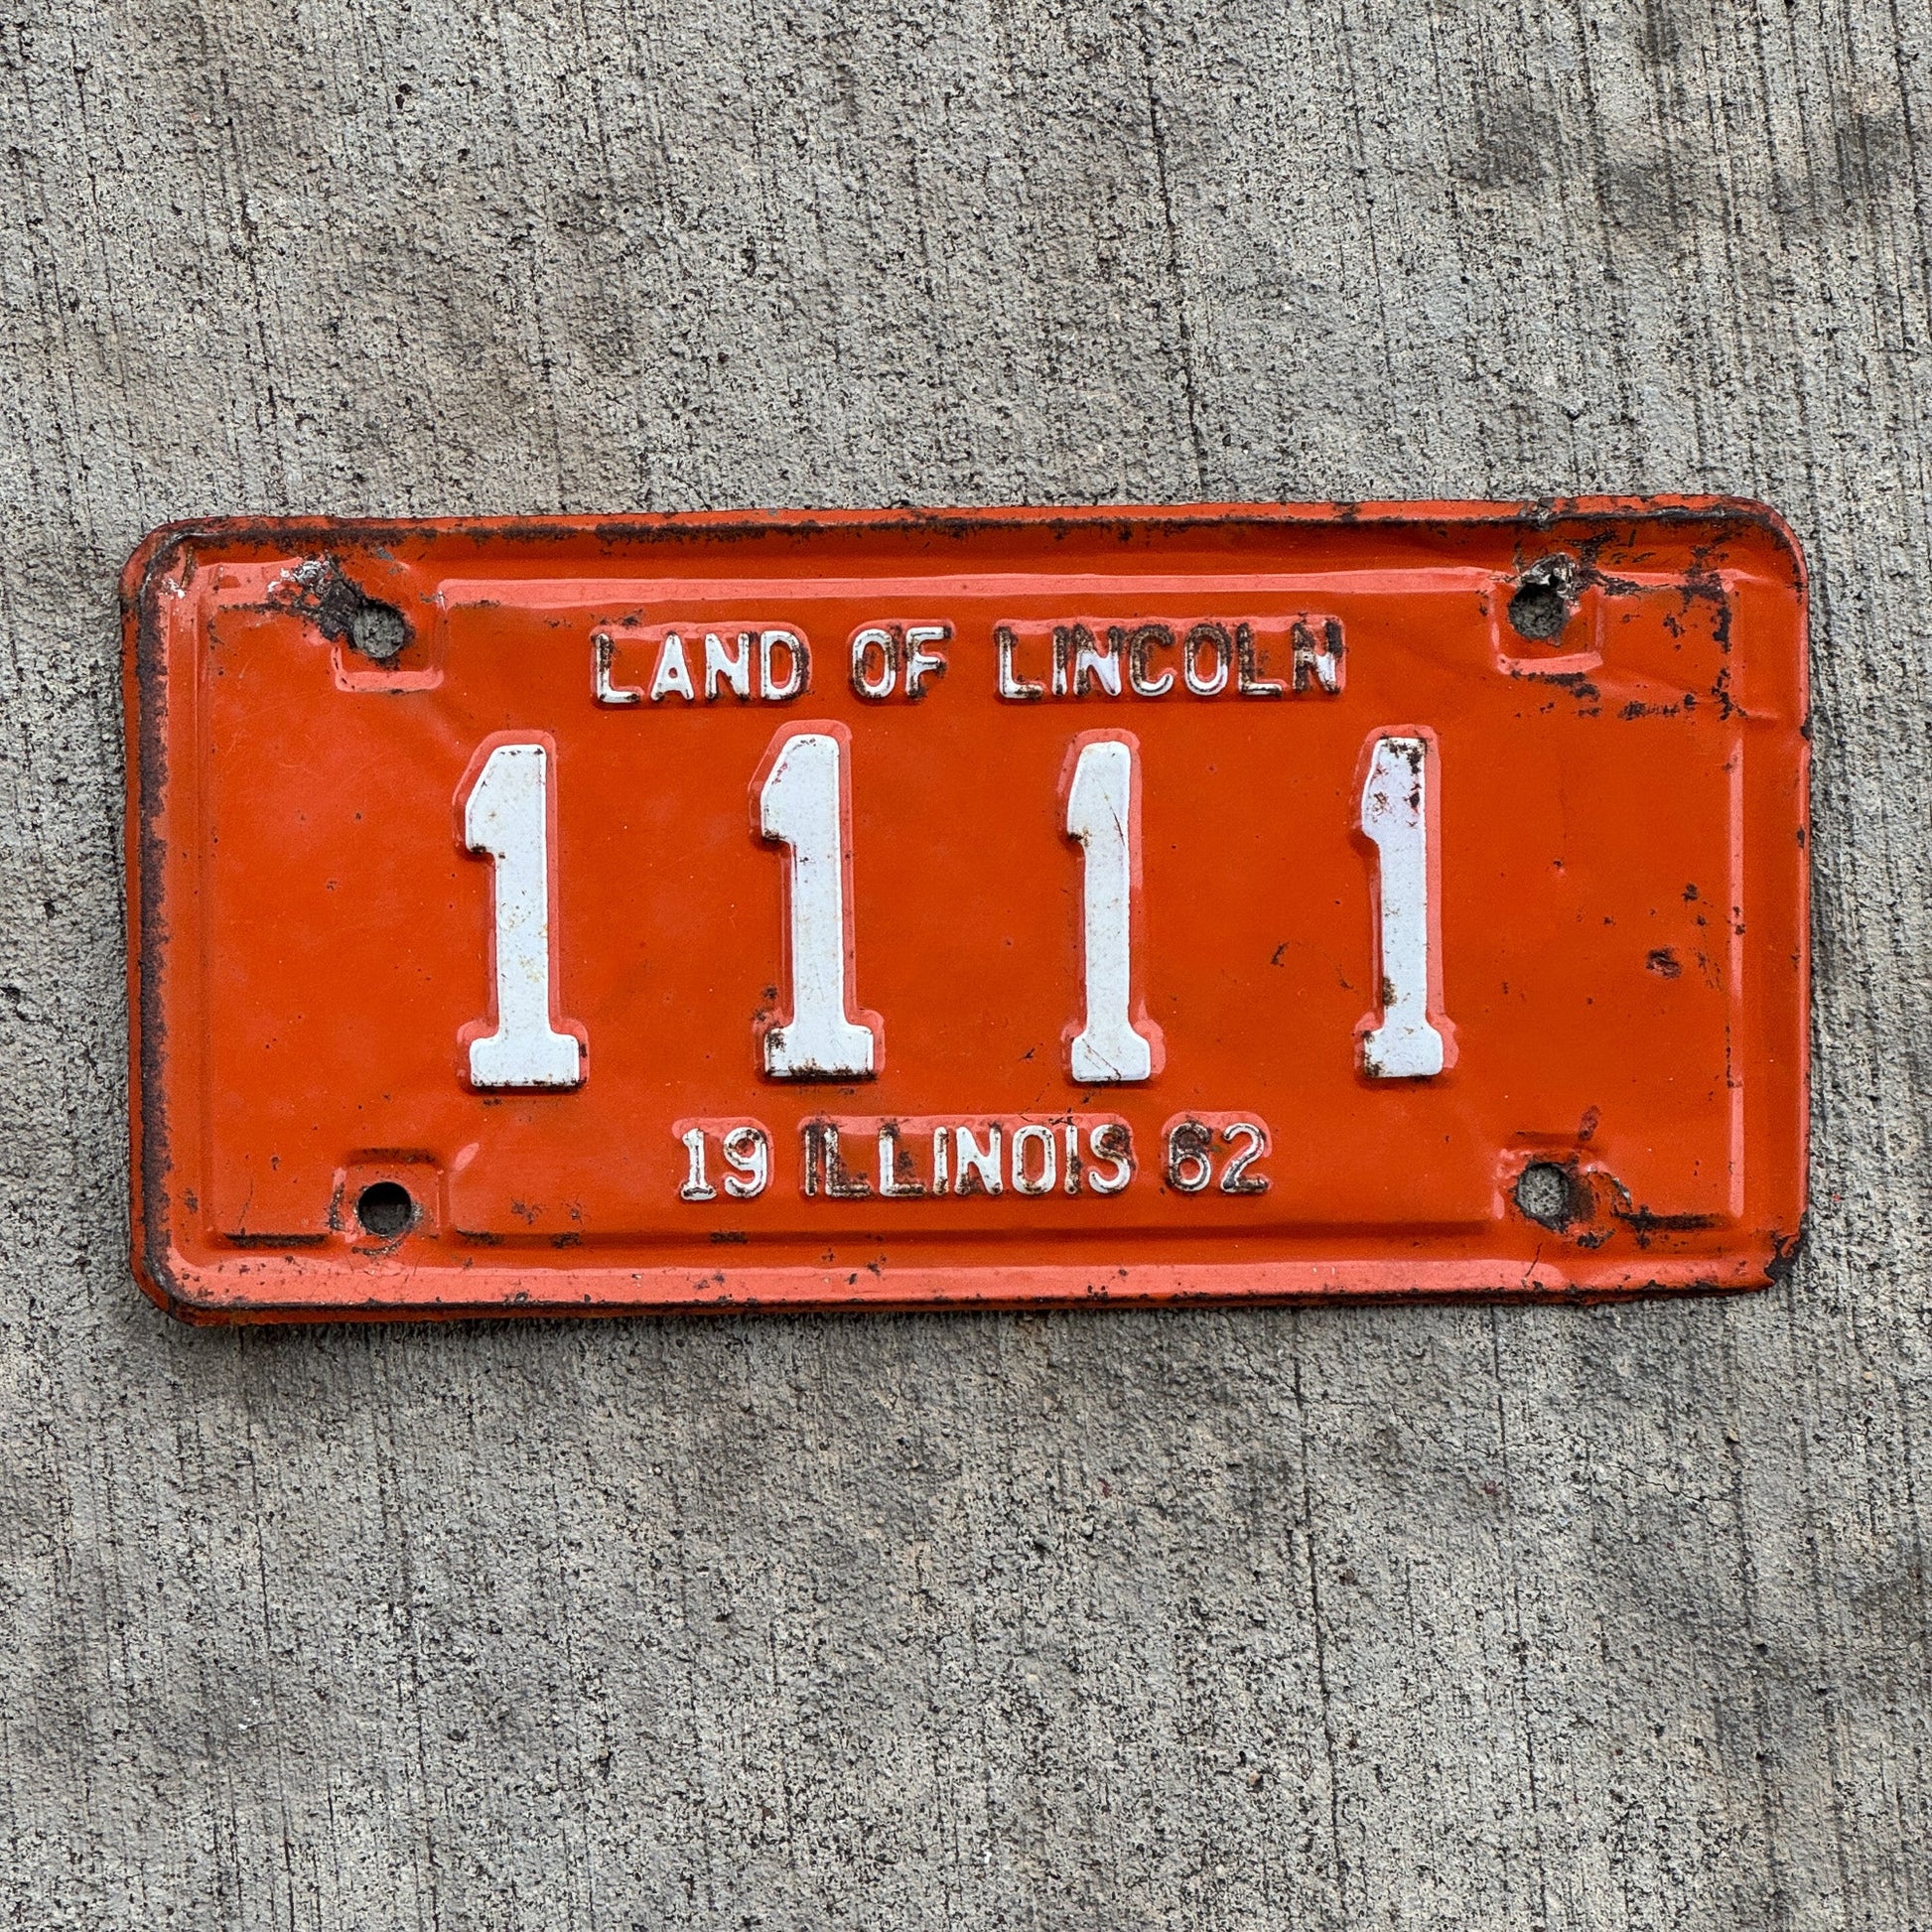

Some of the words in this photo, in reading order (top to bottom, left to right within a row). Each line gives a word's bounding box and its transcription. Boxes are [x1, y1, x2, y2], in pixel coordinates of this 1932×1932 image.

[593, 629, 809, 705] LAND
[849, 625, 951, 703] OF
[995, 618, 1344, 701] LINCOLN
[681, 1125, 768, 1200] 19
[804, 1120, 1134, 1198] ILLINOIS
[1167, 1122, 1270, 1194] 62
